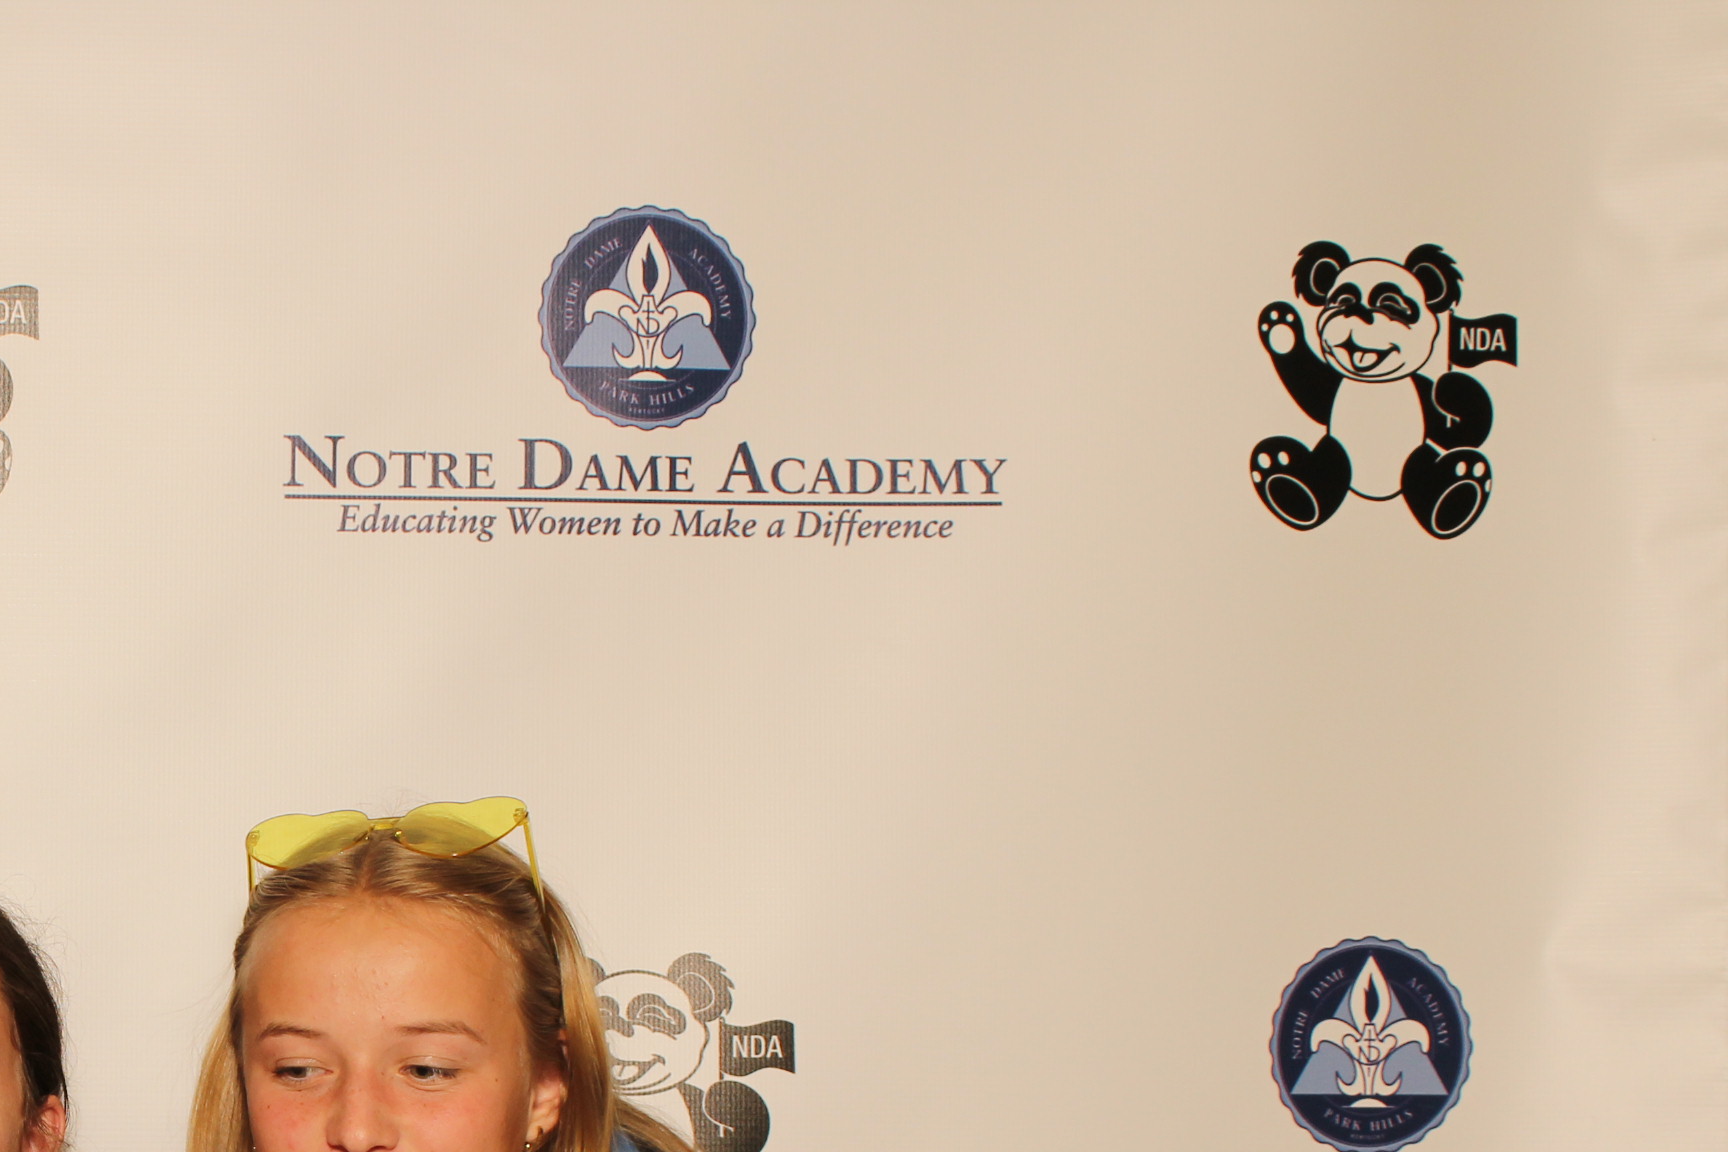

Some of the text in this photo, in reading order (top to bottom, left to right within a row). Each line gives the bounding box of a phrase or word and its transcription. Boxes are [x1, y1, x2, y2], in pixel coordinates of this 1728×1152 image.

[1460, 326, 1507, 352] NDA
[600, 380, 695, 406] PARK HILLS
[283, 435, 1007, 494] NOTRE DAME ACADEMY
[337, 503, 953, 546] Educating Women to Make a Difference
[732, 1034, 783, 1058] NDA
